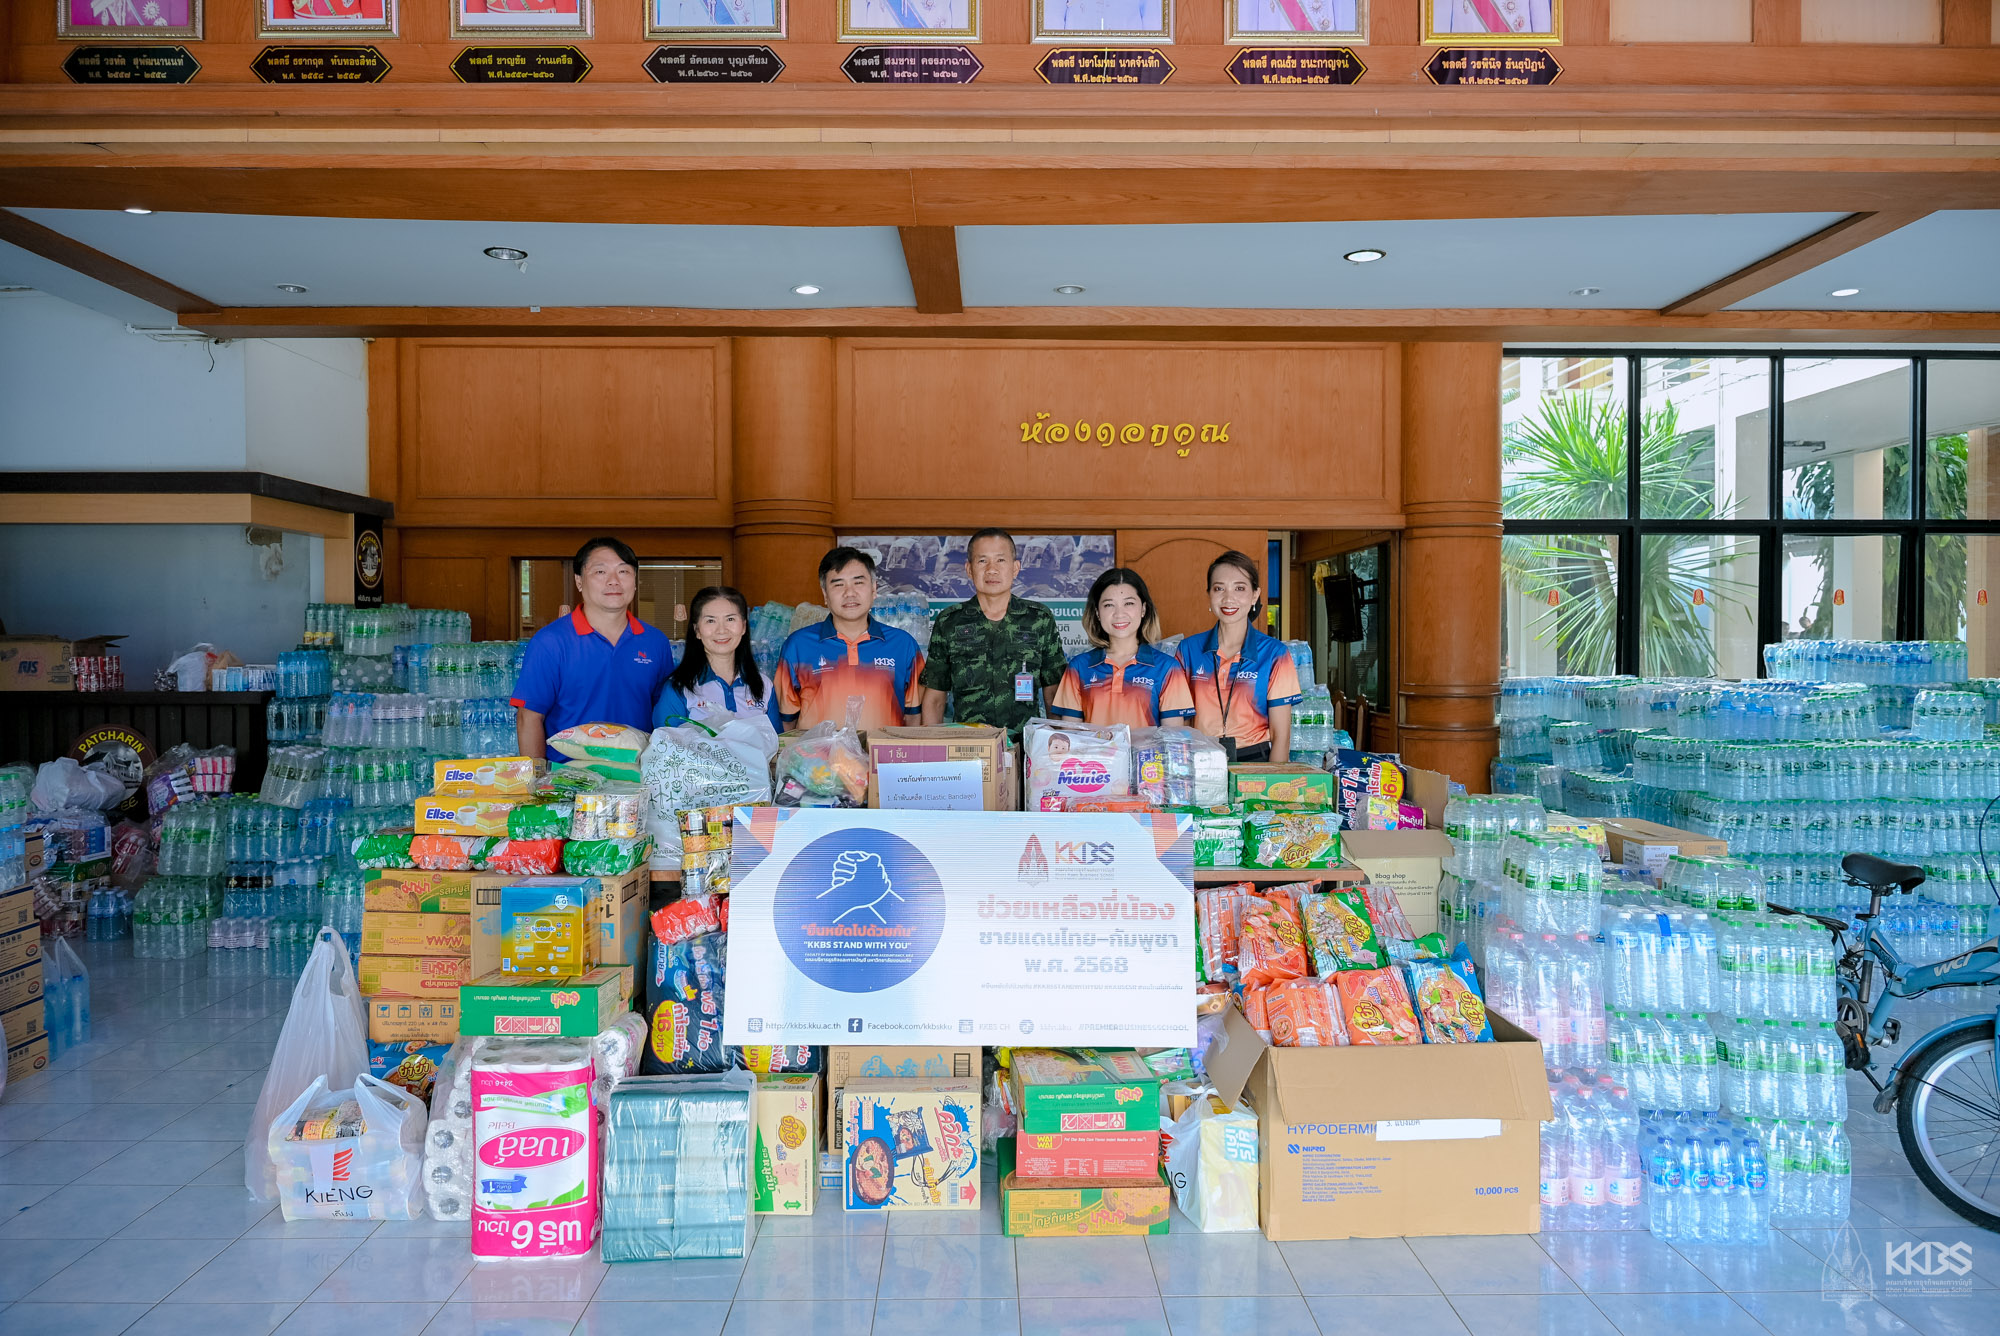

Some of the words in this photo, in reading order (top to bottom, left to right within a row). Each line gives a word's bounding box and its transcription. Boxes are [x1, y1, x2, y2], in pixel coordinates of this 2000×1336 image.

[267, 55, 290, 66] พลตรี
[469, 54, 493, 65] พลตรี
[497, 54, 526, 67] ชาญชัย
[536, 54, 573, 65] ว่านเครือ
[659, 54, 685, 65] พลตรี
[690, 55, 724, 65] อัครเดช
[728, 54, 768, 67] บุญเทียม
[853, 55, 880, 66] พลตรี
[884, 57, 916, 65] สมชาย
[1052, 55, 1075, 68] พลตรี
[1078, 54, 1116, 68] ปราโมทย์
[1242, 55, 1267, 68] พลตรี
[1300, 54, 1349, 71] ชนะกาญจน์
[1442, 57, 1467, 69] พลตรี
[870, 70, 889, 78] พ.ศ.
[1020, 412, 1231, 457] ห้องดอกคูณ
[874, 657, 895, 667] KKBS
[1132, 676, 1154, 686] KKBS
[78, 730, 145, 754] PATCHARIN
[897, 773, 962, 783] เวชภัณฑ์ทางการแพทย์
[1344, 790, 1357, 808] ฟรี
[1055, 841, 1115, 865] KKBS
[401, 876, 430, 894] มาม่า
[1392, 872, 1406, 880] shop
[439, 882, 471, 897] รสหมูสั
[977, 888, 1175, 921] ช่วยเหลือพี่น้อง
[1277, 920, 1301, 947] ยำยำ
[1344, 914, 1370, 943] ยำยำ
[426, 935, 463, 948] MAMA
[833, 941, 863, 949] STAND
[865, 941, 887, 949] WITH
[1023, 955, 1068, 974] พ.ศ.
[1073, 955, 1129, 974] 2568
[551, 991, 580, 1009] มาม่า
[701, 991, 715, 1015] ฟรี
[1460, 990, 1485, 1028] ยำยำ
[657, 1009, 671, 1031] 16
[765, 1022, 841, 1031] http://kkbs.kku.ac.th
[868, 1022, 952, 1031] Facebook.com/kkbskku
[673, 1003, 690, 1061] กำไรเพิ่ม
[698, 1029, 712, 1051] ห่อ
[751, 1048, 759, 1068] บาท
[398, 1057, 430, 1080] ยำยำ
[1115, 1087, 1143, 1105] มาม่า
[781, 1115, 801, 1150] ยำยำ
[1287, 1124, 1377, 1135] HYPODERMI
[493, 1136, 570, 1166] เบลล์
[305, 1185, 373, 1203] KIENG
[1475, 1187, 1502, 1196] 10,000
[1504, 1186, 1519, 1194] PCS
[478, 1219, 511, 1235] ม้วน
[1090, 1209, 1126, 1229] มาม่า
[511, 1221, 535, 1249] 6
[539, 1220, 582, 1248] ฟรี
